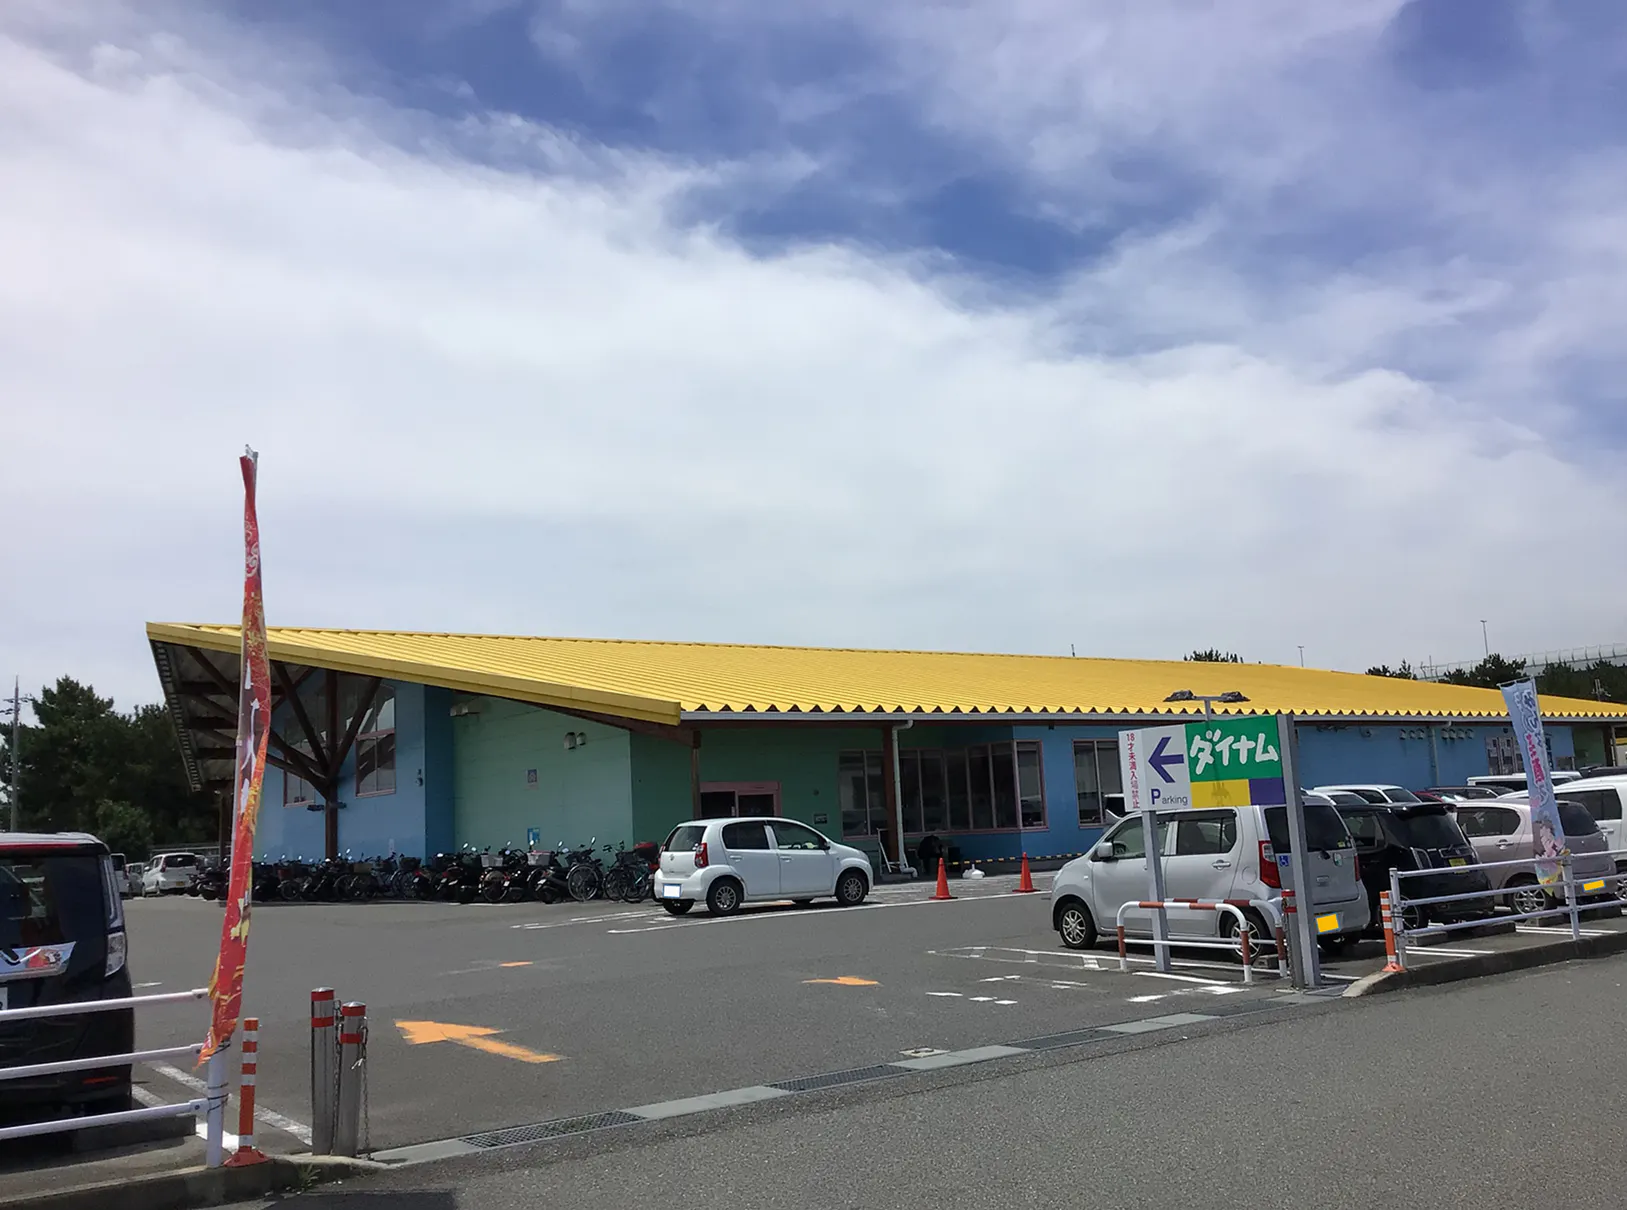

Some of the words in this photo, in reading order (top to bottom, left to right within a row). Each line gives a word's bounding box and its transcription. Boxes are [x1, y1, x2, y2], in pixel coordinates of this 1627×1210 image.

[1190, 729, 1279, 775] ダイナム
[1151, 788, 1188, 805] Parking
